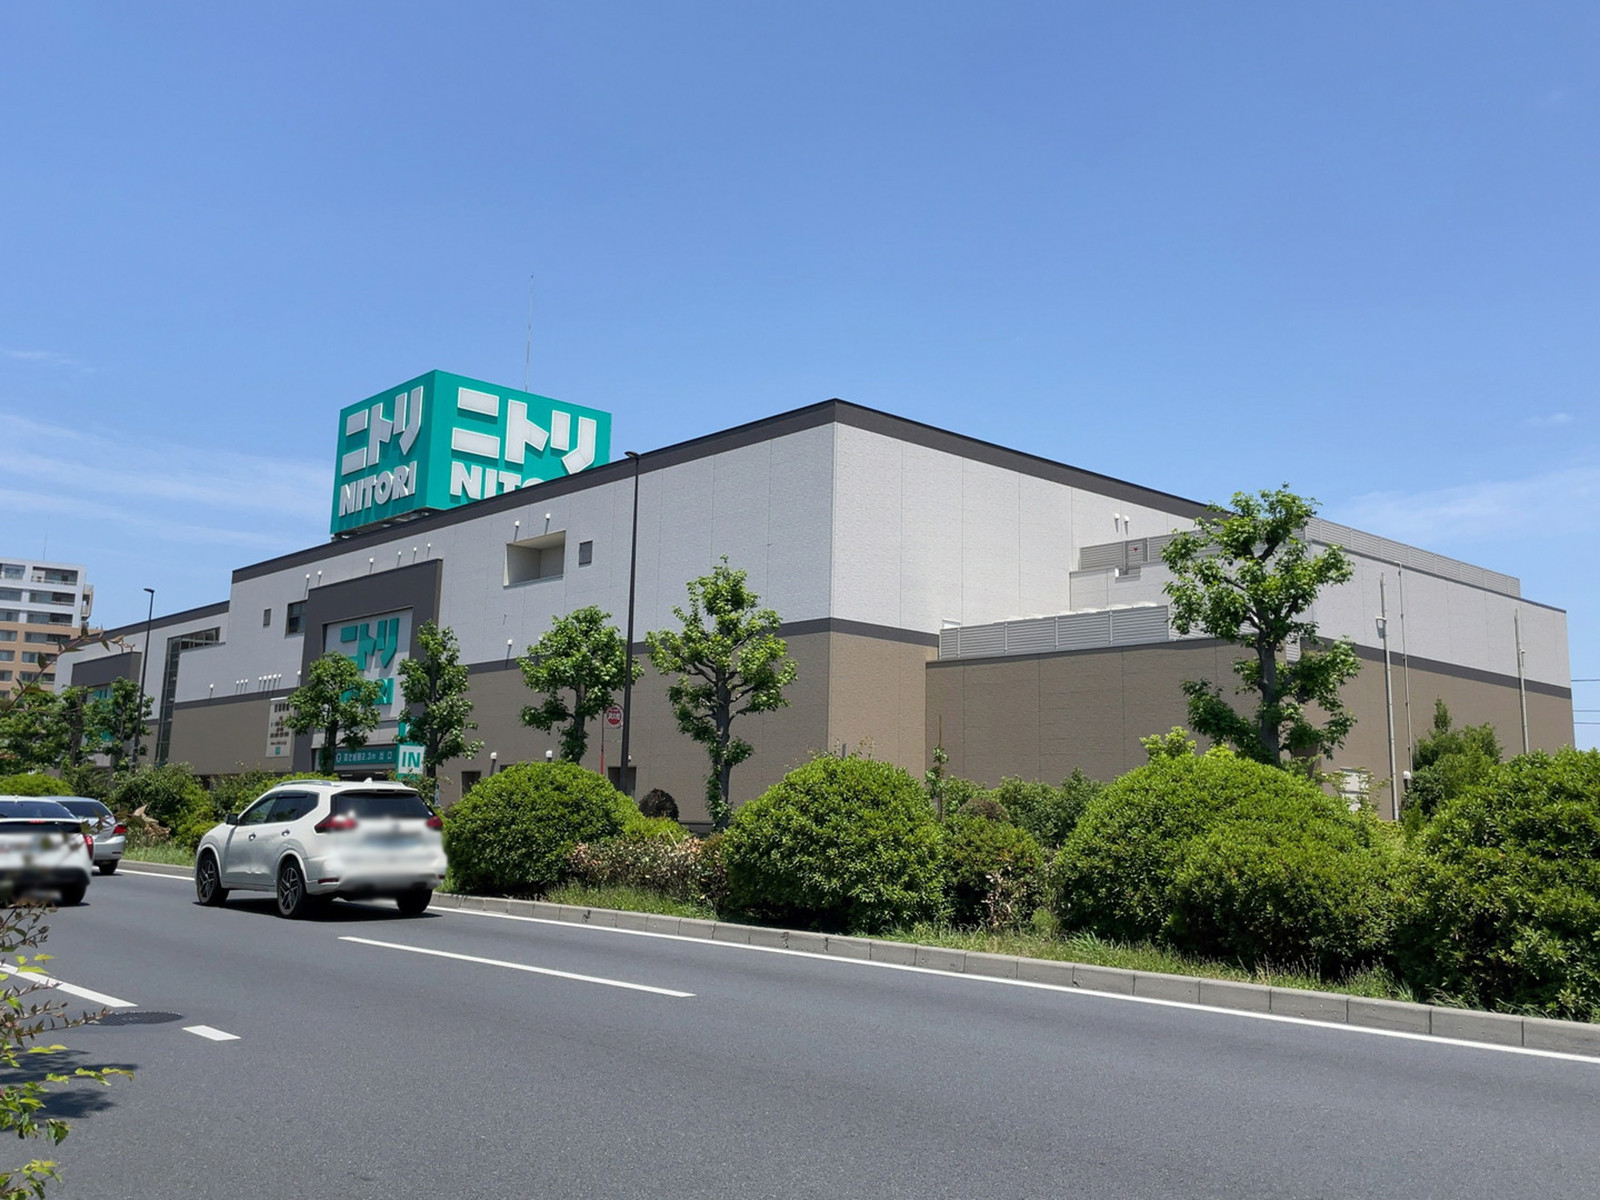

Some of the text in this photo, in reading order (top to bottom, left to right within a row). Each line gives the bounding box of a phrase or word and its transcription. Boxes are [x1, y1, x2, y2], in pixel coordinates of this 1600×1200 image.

[341, 385, 424, 476] ニトリ
[451, 386, 597, 475] ニトリ
[340, 461, 417, 516] NITORI
[402, 751, 421, 768] IN
